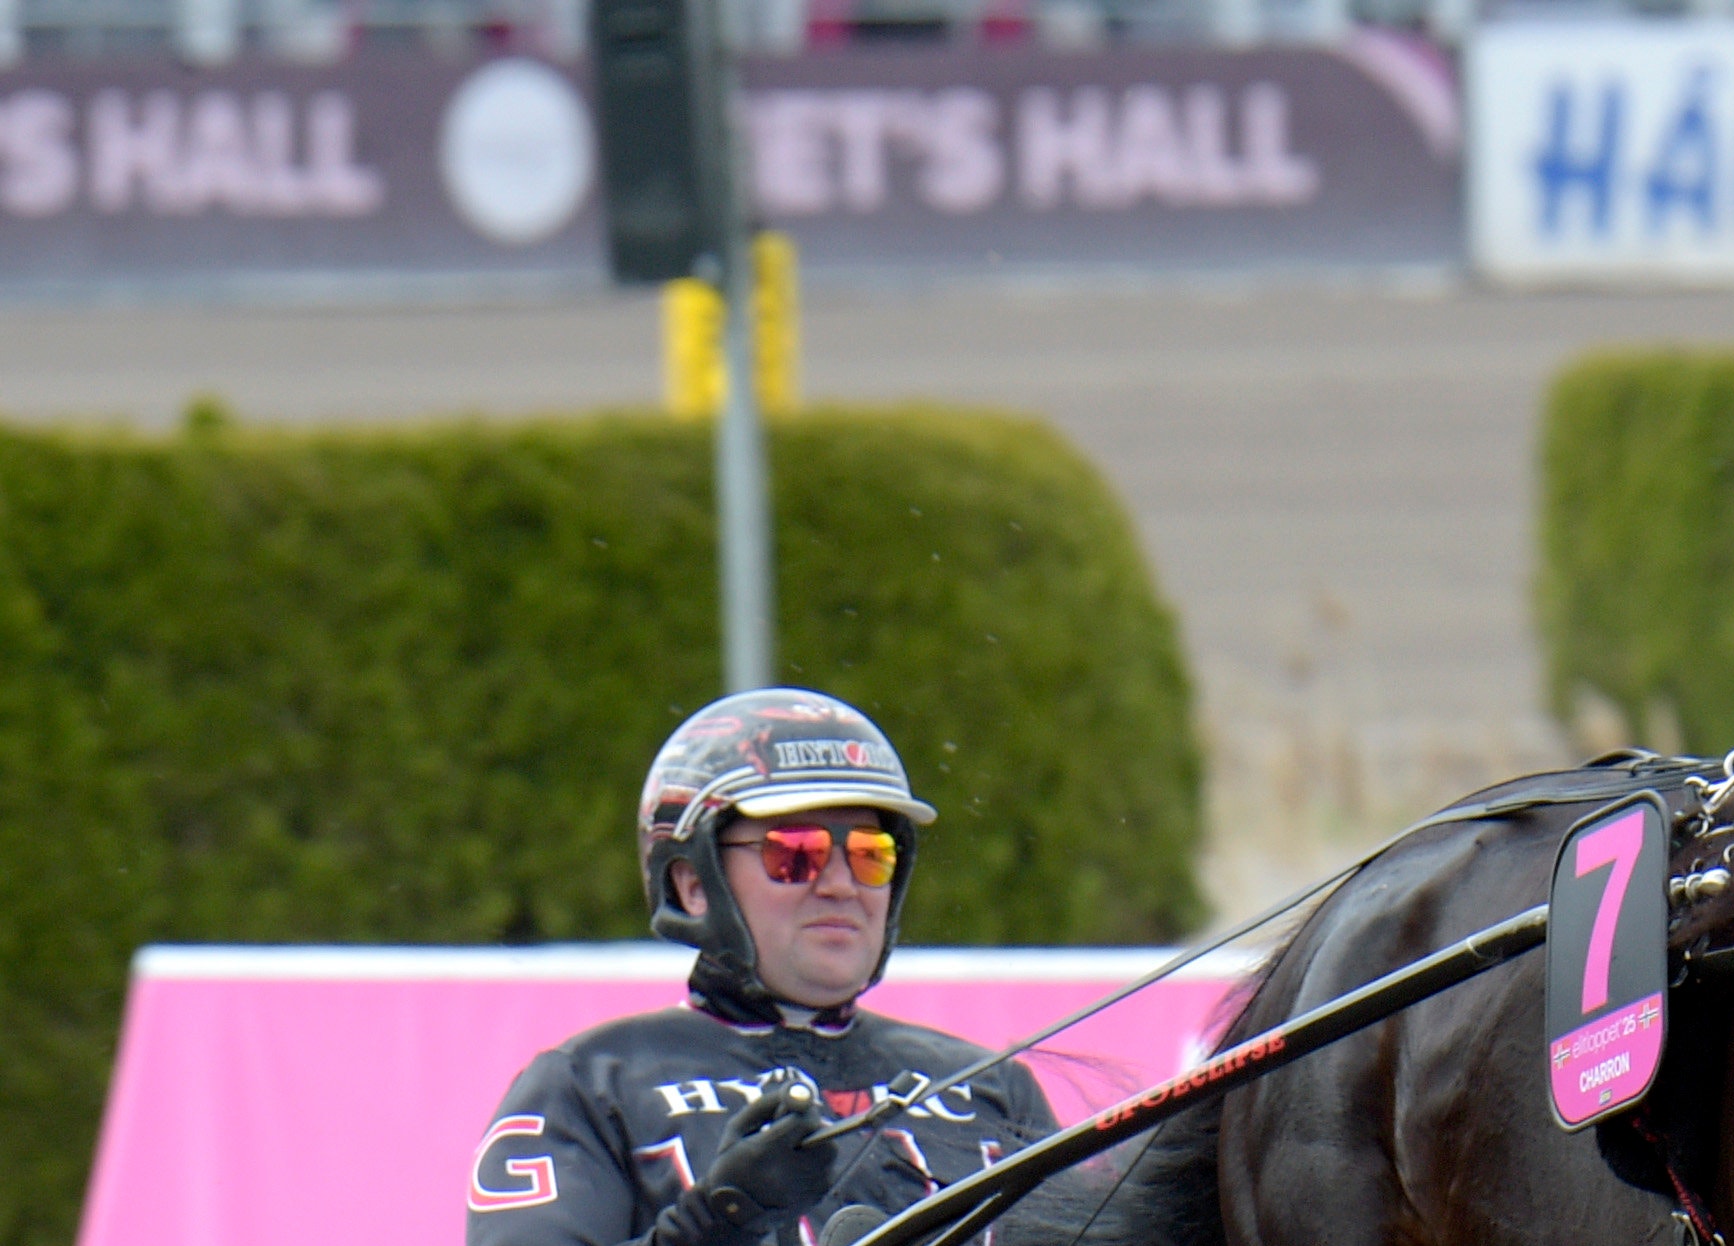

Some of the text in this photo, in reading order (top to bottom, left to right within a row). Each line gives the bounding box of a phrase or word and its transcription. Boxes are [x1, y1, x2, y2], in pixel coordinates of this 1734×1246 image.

[88, 86, 386, 214] HALL
[1018, 80, 1318, 208] HALL
[1575, 809, 1646, 1016] 7
[1579, 1052, 1631, 1093] CHARRON
[467, 1114, 558, 1212] G
